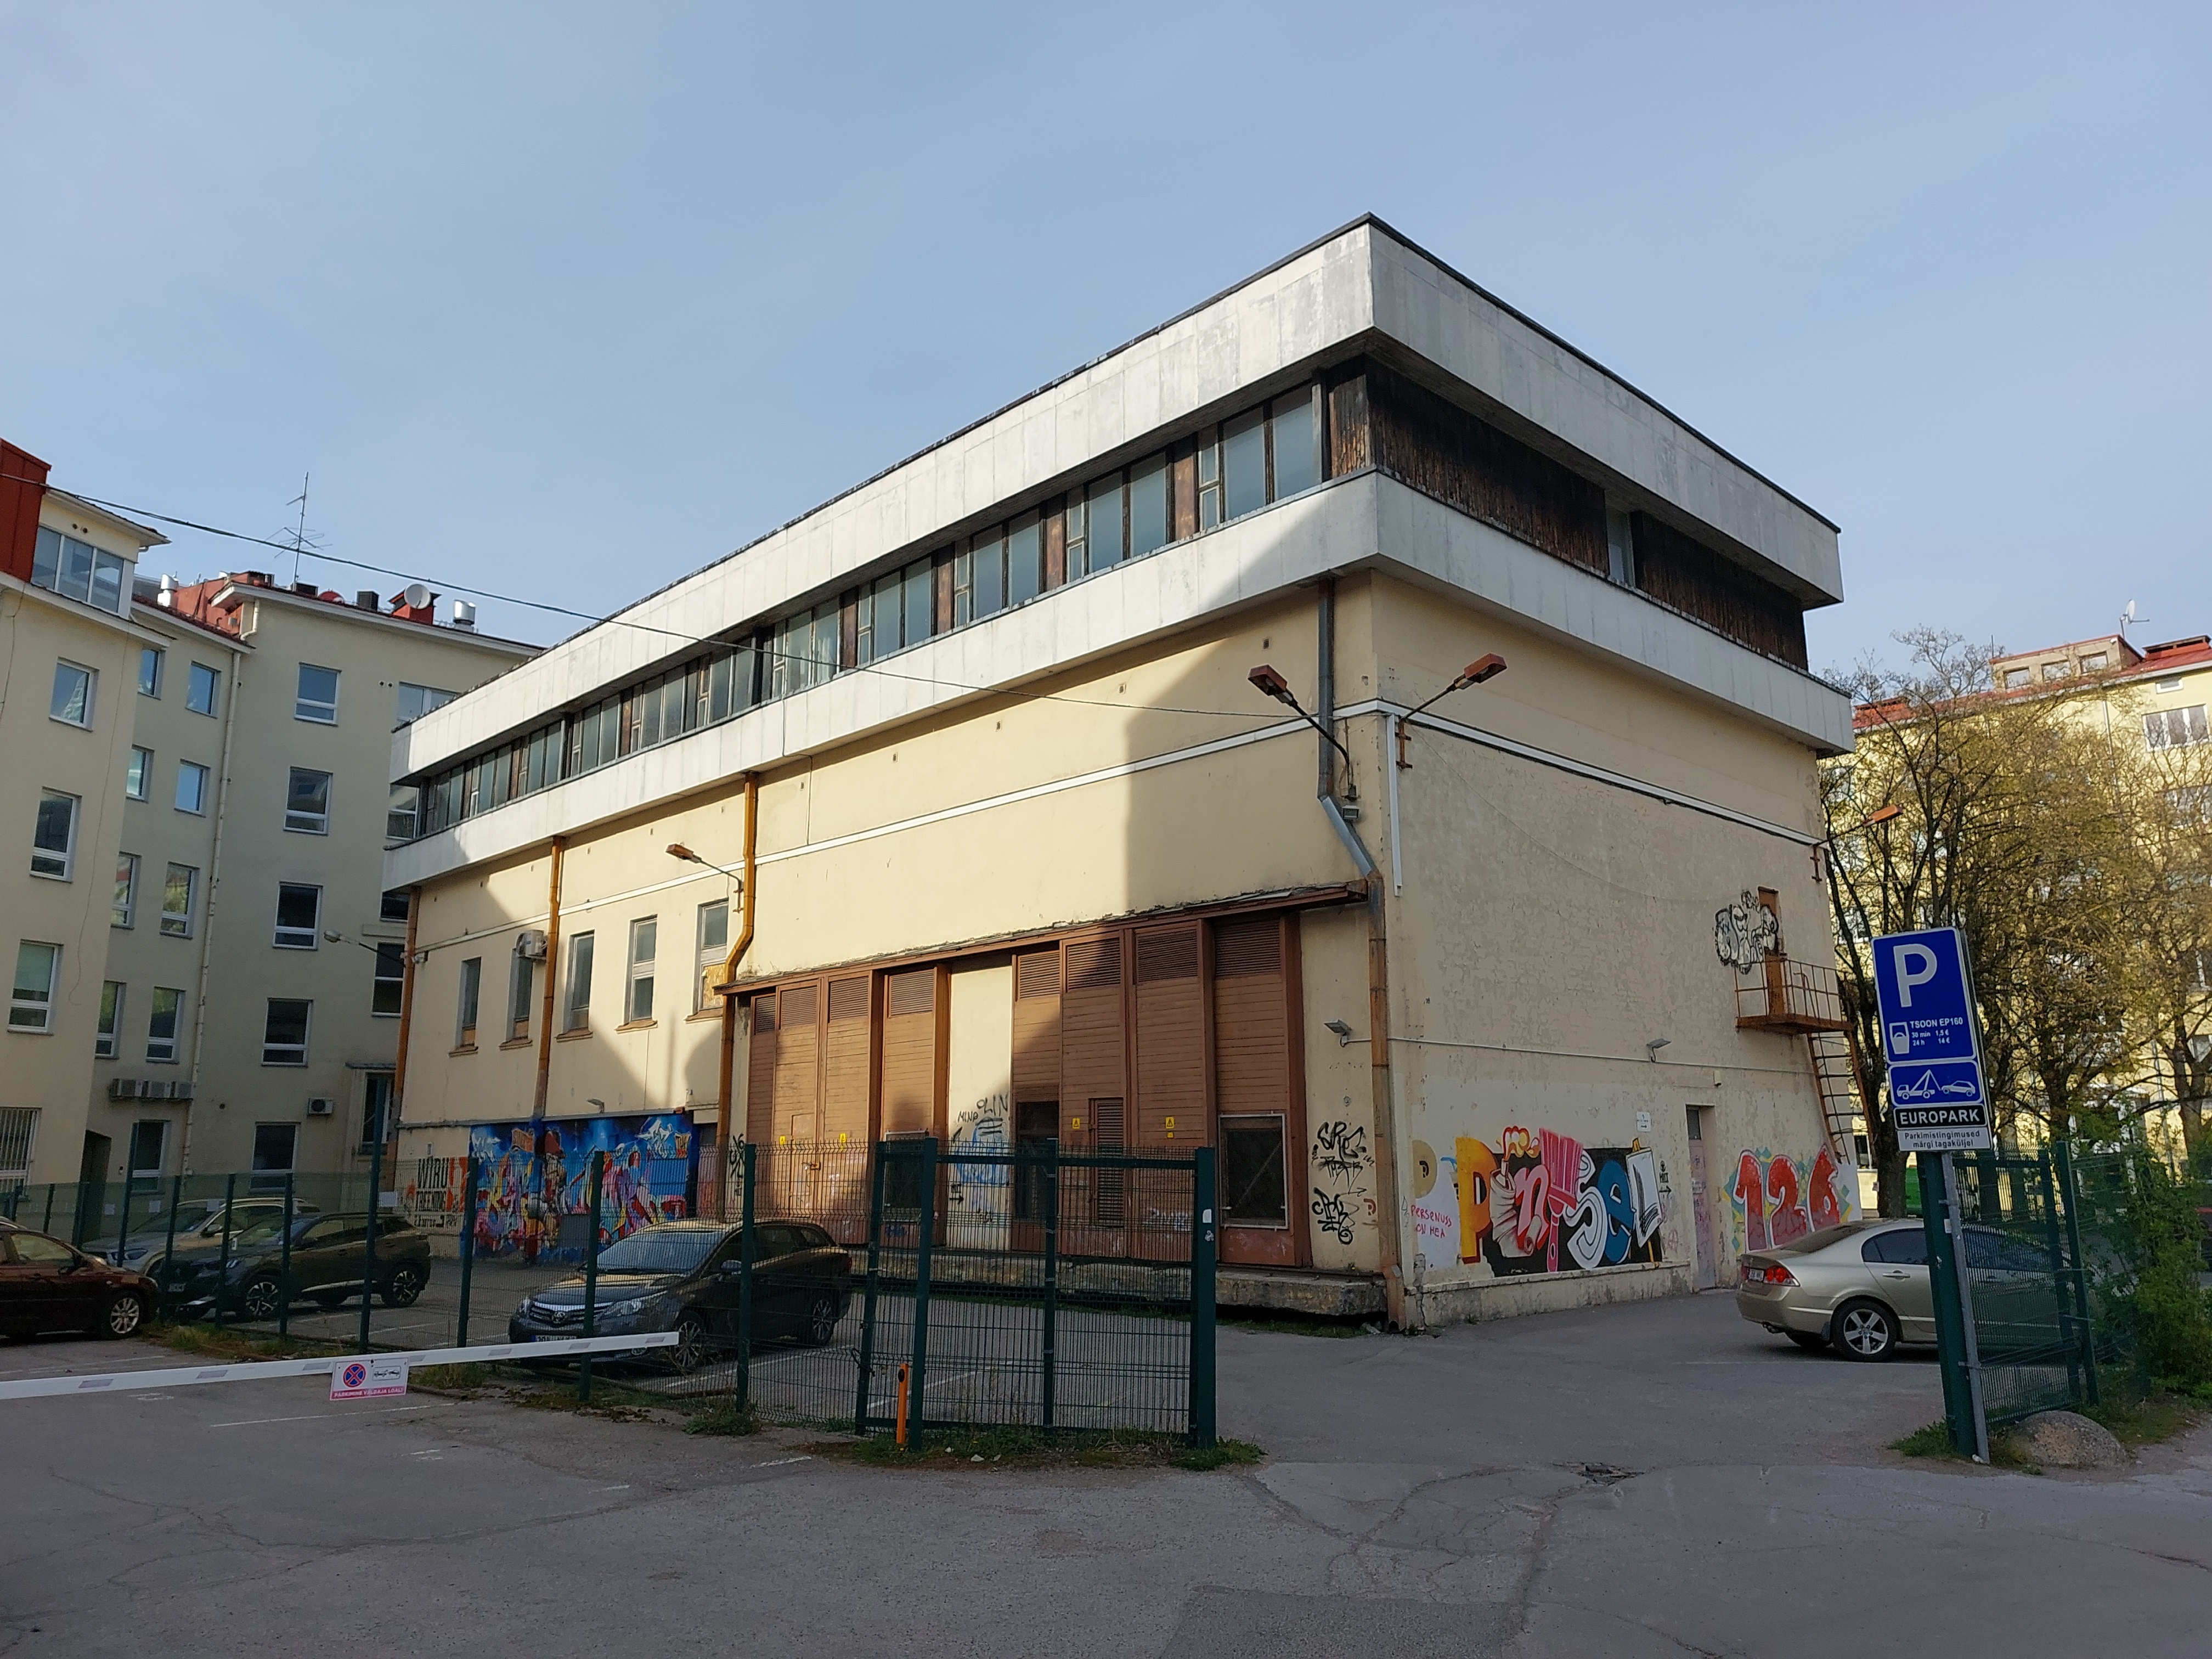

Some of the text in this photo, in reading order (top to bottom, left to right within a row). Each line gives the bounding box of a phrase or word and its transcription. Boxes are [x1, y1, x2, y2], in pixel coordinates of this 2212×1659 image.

[1893, 943, 1938, 1008] P
[1910, 1017, 1963, 1029] TSOON EP160
[976, 1094, 1008, 1116] OLIN
[1899, 1109, 1980, 1125] EUROPARK
[1904, 1130, 1980, 1140] Parkimistingimused
[1913, 1139, 1974, 1149] märgi tagaküljel
[1415, 1223, 1426, 1235] ON
